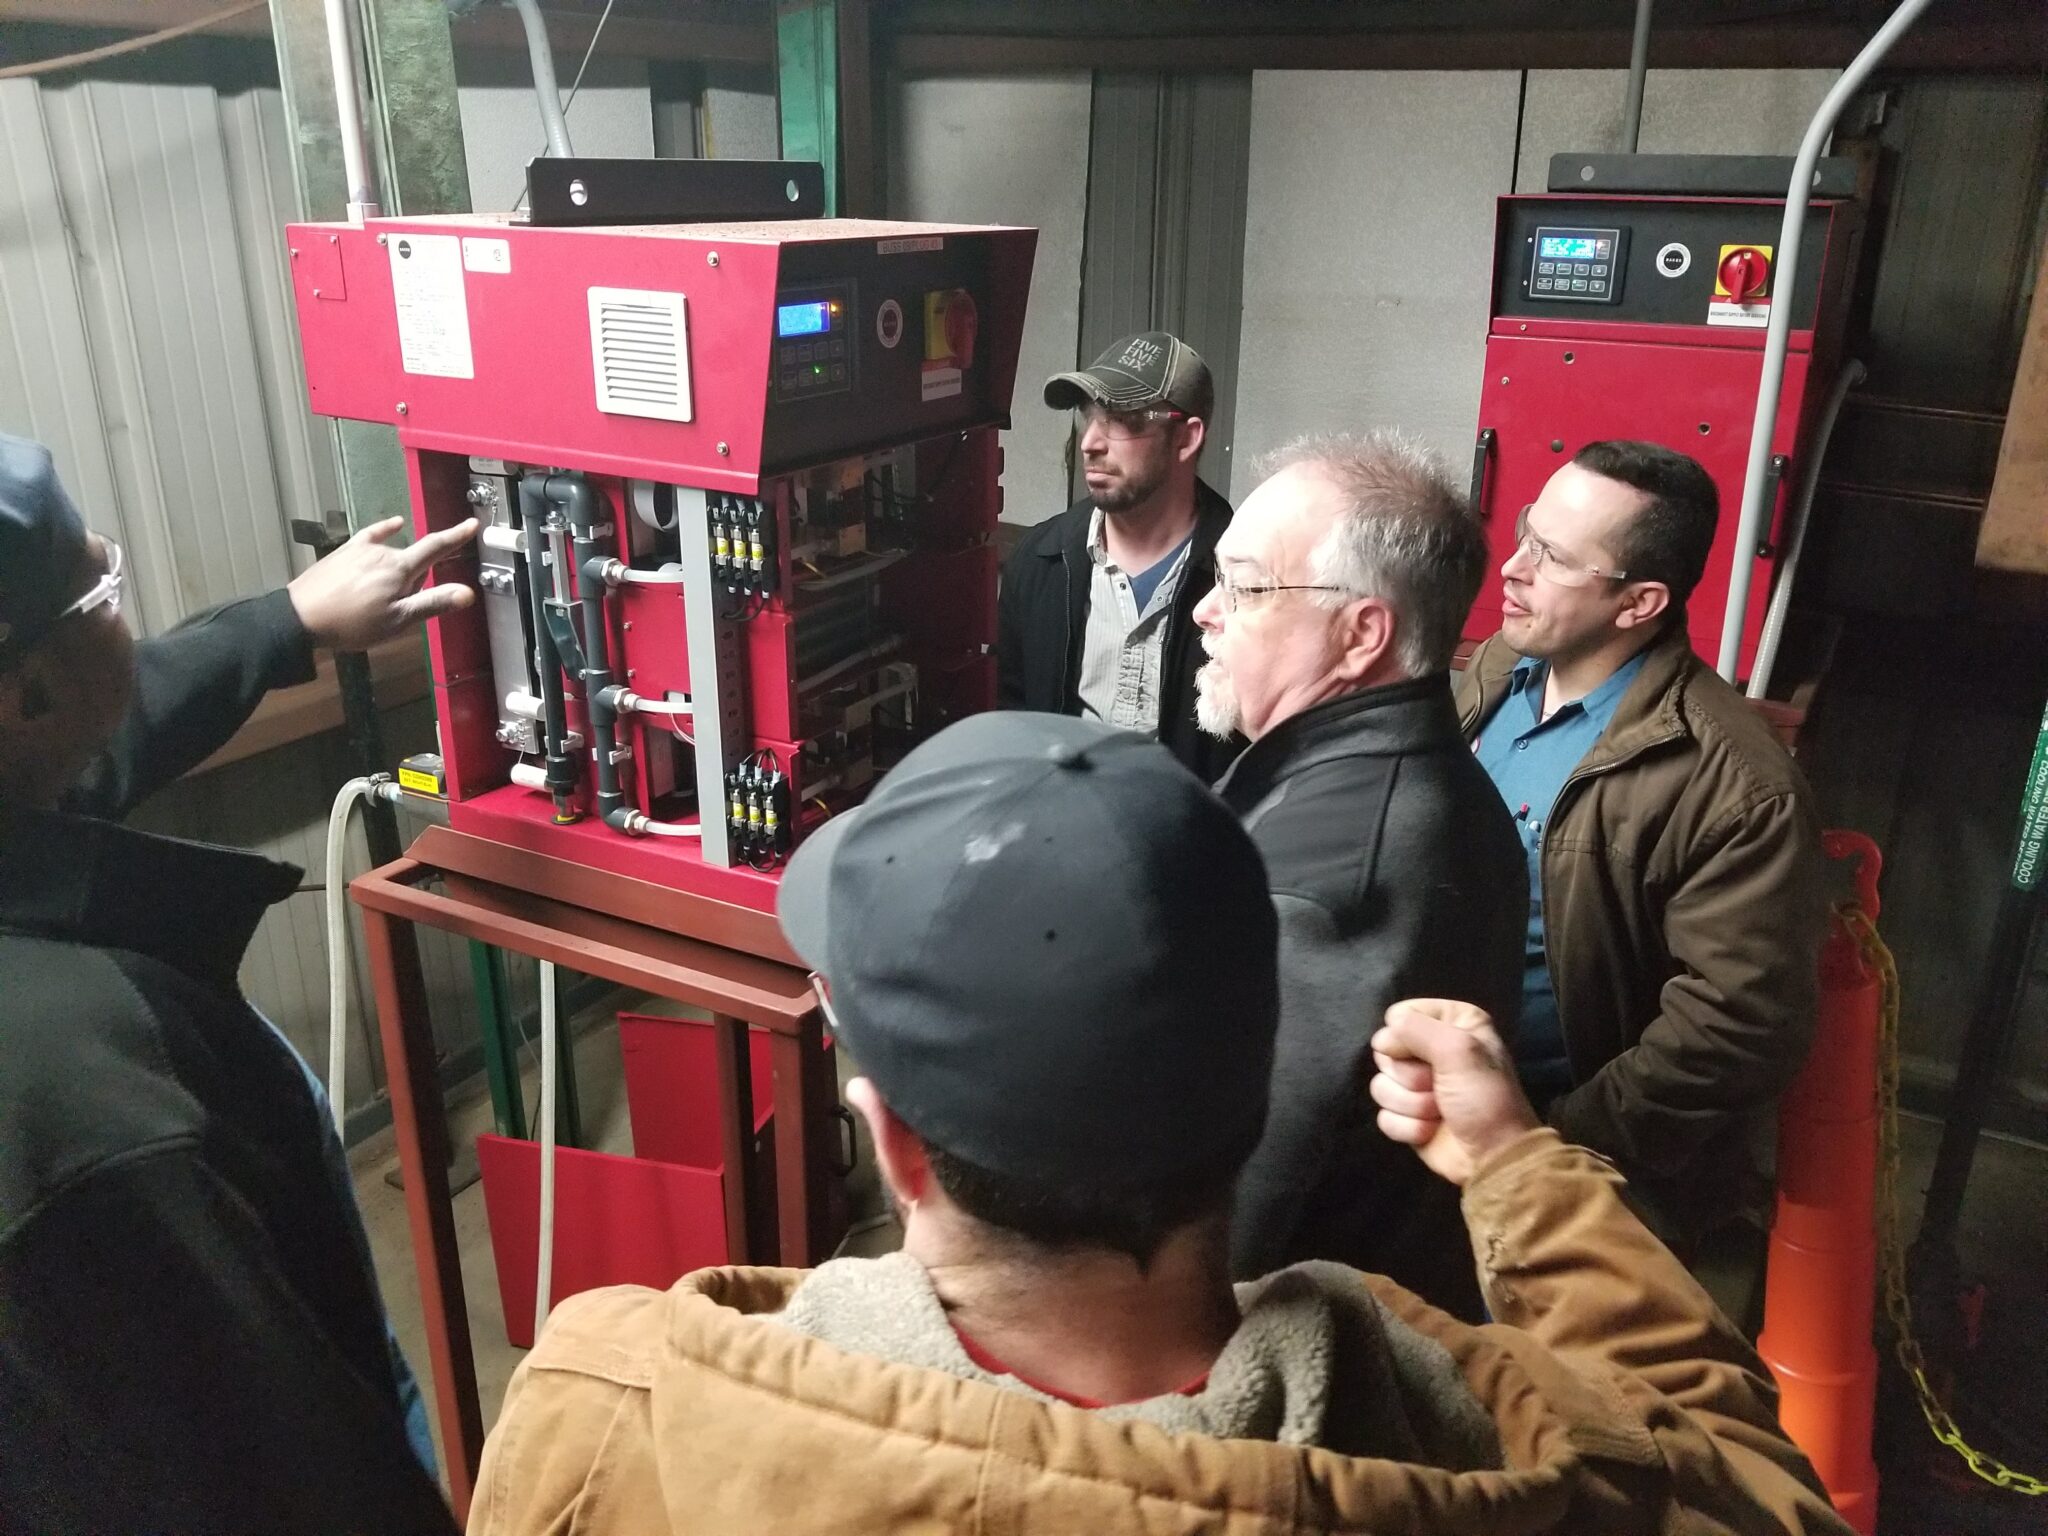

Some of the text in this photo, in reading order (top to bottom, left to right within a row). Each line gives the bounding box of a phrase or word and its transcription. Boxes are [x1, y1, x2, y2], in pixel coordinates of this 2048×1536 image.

[1125, 346, 1158, 366] FIVE
[1132, 338, 1163, 358] FIVE
[1118, 356, 1146, 371] SIX
[2031, 760, 2048, 805] COOLING
[2017, 840, 2041, 884] COOLING
